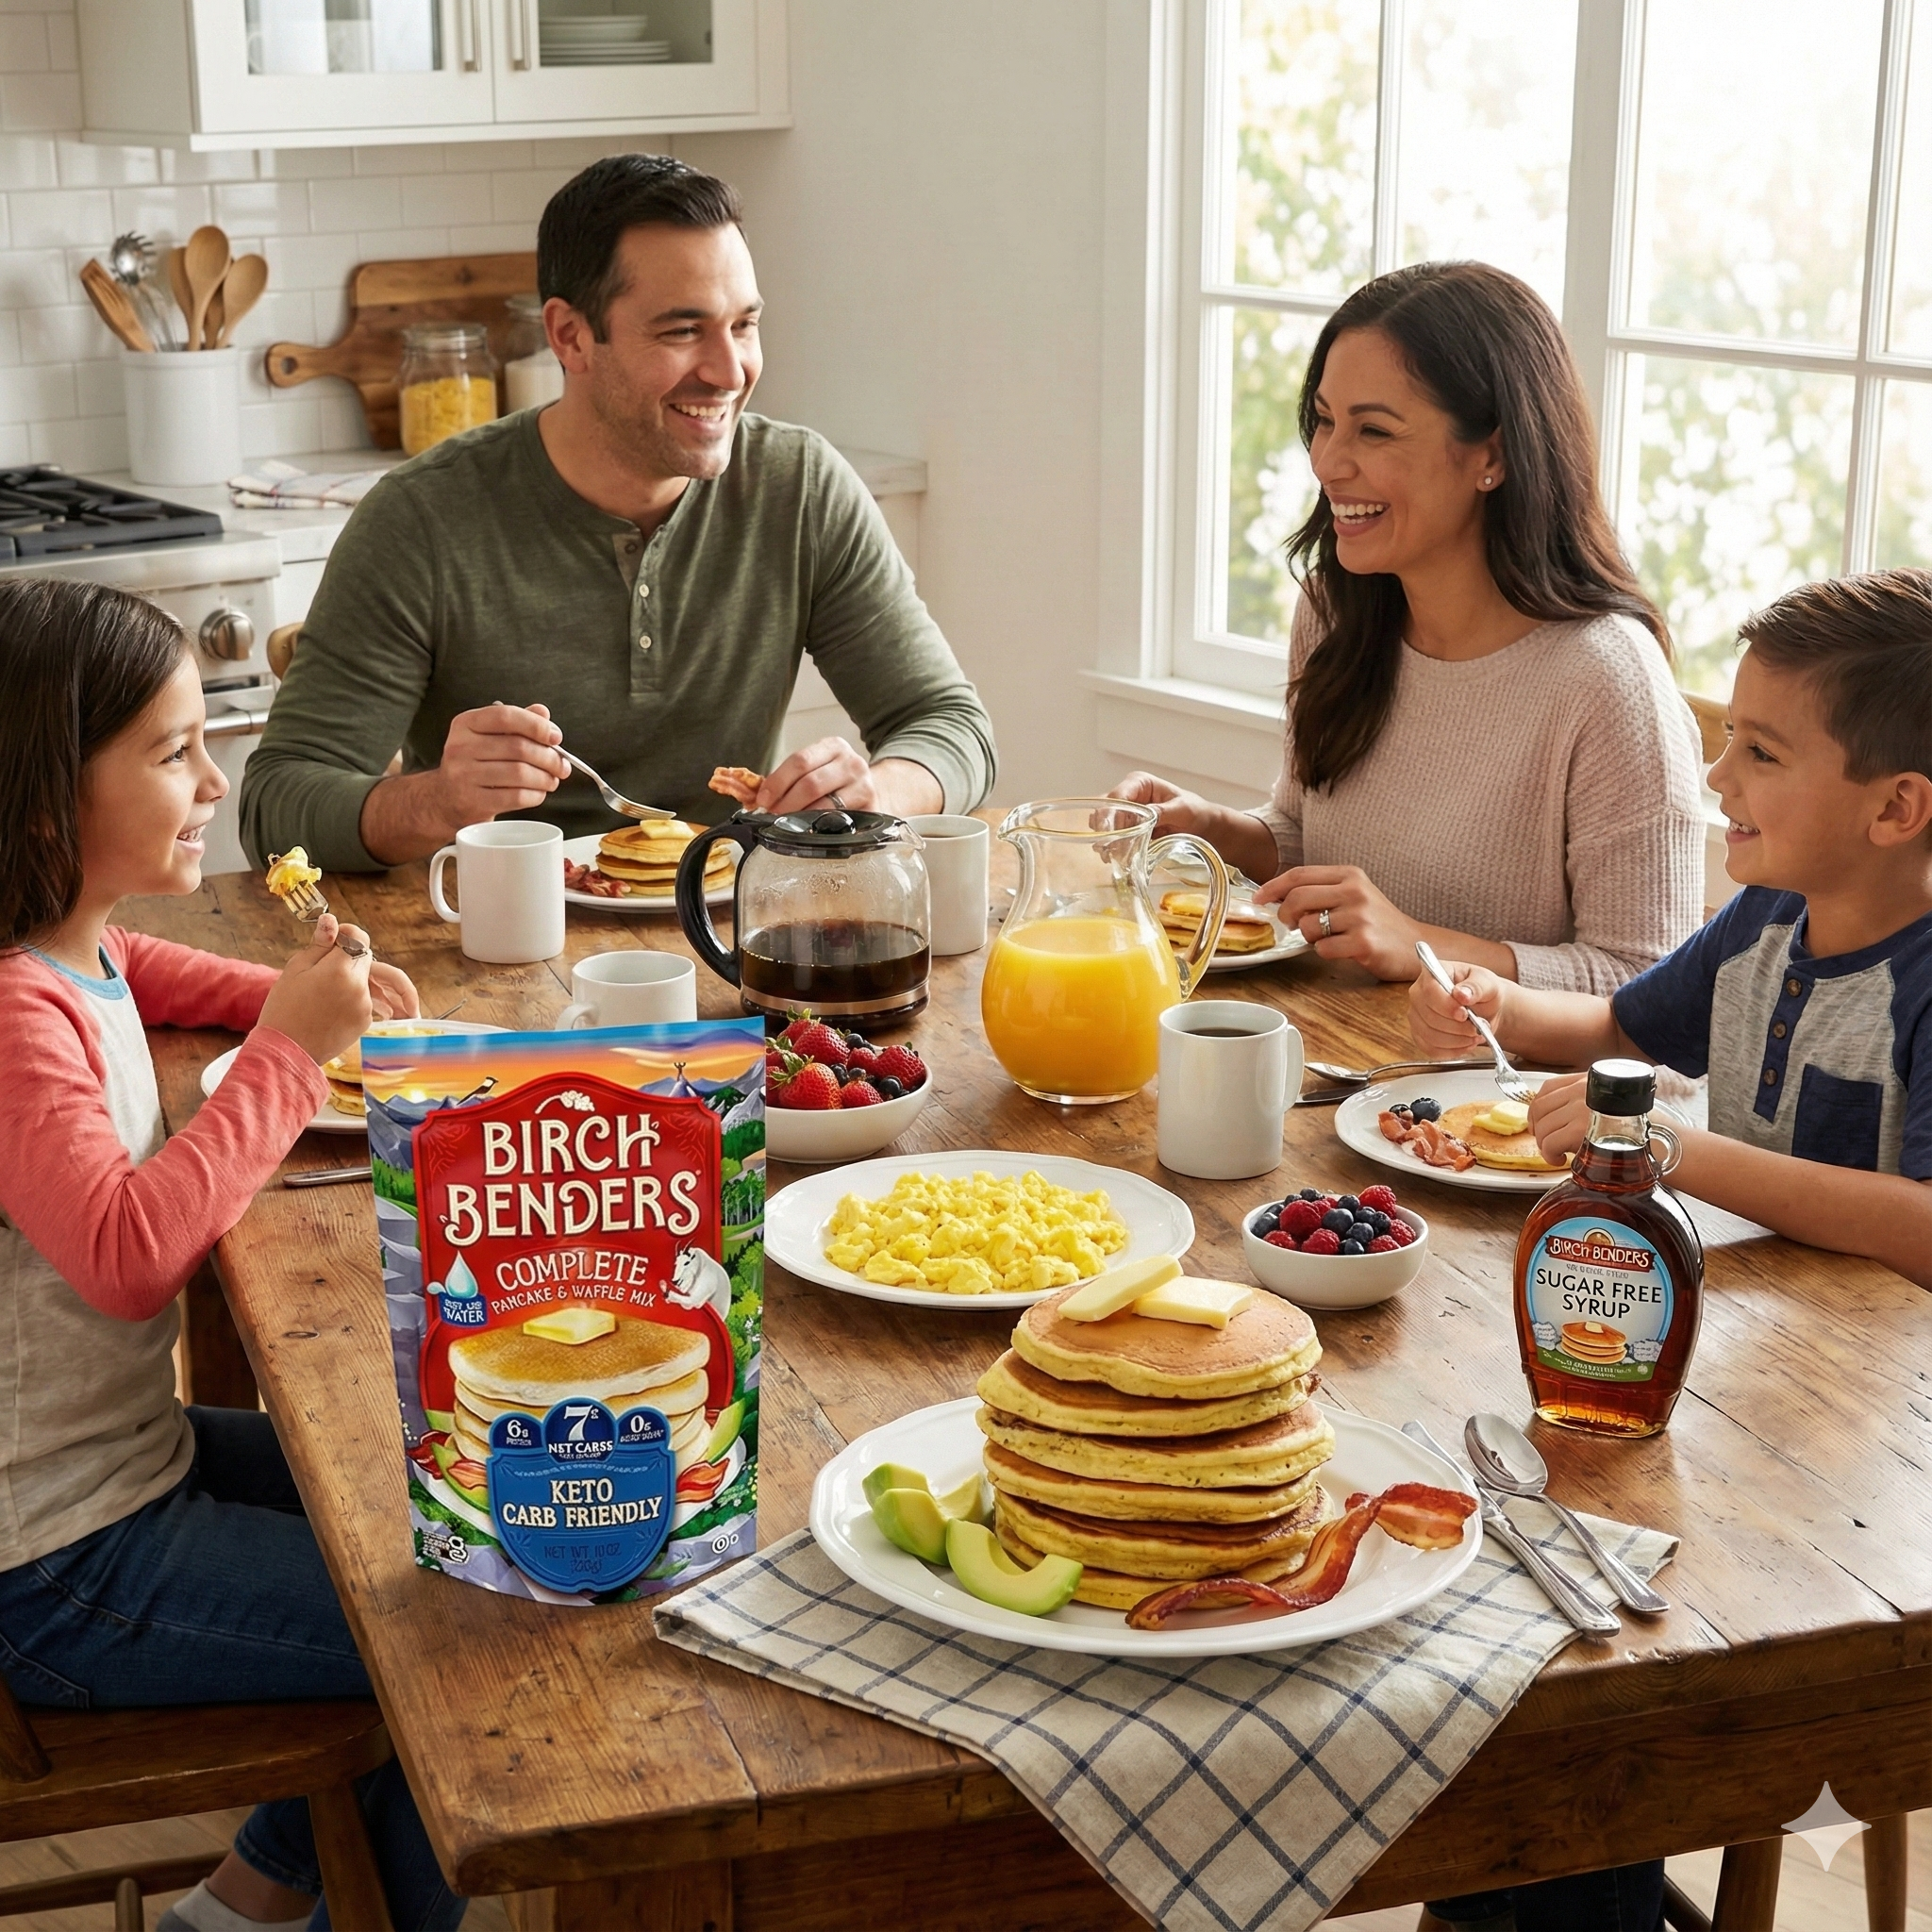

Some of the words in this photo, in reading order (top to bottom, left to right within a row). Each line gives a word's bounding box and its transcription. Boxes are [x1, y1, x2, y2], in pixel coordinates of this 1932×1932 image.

[483, 1113, 660, 1176] BIRCH
[441, 1170, 702, 1247] BENDERS
[495, 1251, 650, 1291] COMPLETE
[1536, 1268, 1606, 1298] SUGAR
[1612, 1282, 1662, 1304] FREE
[491, 1285, 554, 1315] PANCAKE
[557, 1285, 568, 1299] &
[571, 1284, 625, 1301] WAFFLE
[629, 1289, 657, 1307] MIX
[1562, 1293, 1631, 1319] SYRUP
[550, 1477, 613, 1504] KETO
[502, 1503, 557, 1527] CARB
[565, 1496, 662, 1528] FRIENDLY
